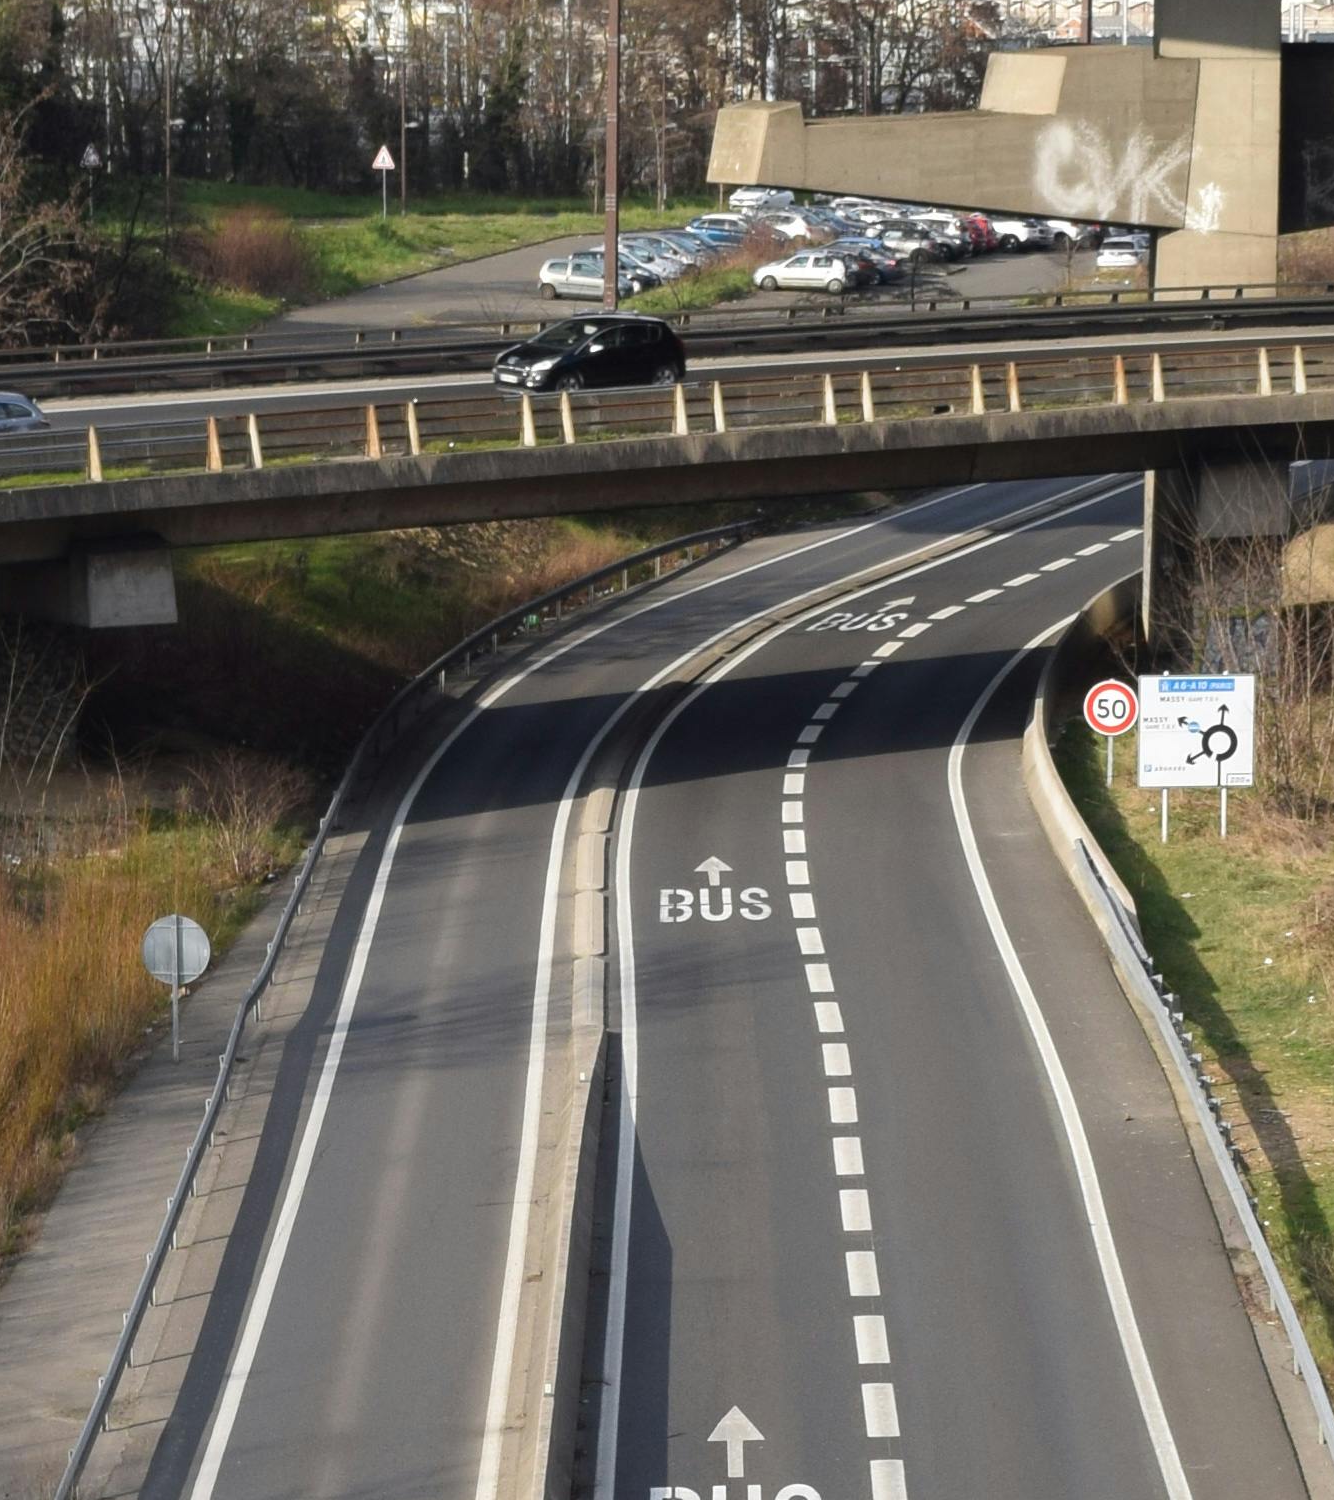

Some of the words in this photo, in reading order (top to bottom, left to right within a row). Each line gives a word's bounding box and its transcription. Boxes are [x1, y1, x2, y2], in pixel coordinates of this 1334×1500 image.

[805, 611, 910, 633] BUS
[1096, 699, 1127, 719] 50
[659, 886, 772, 923] BUS
